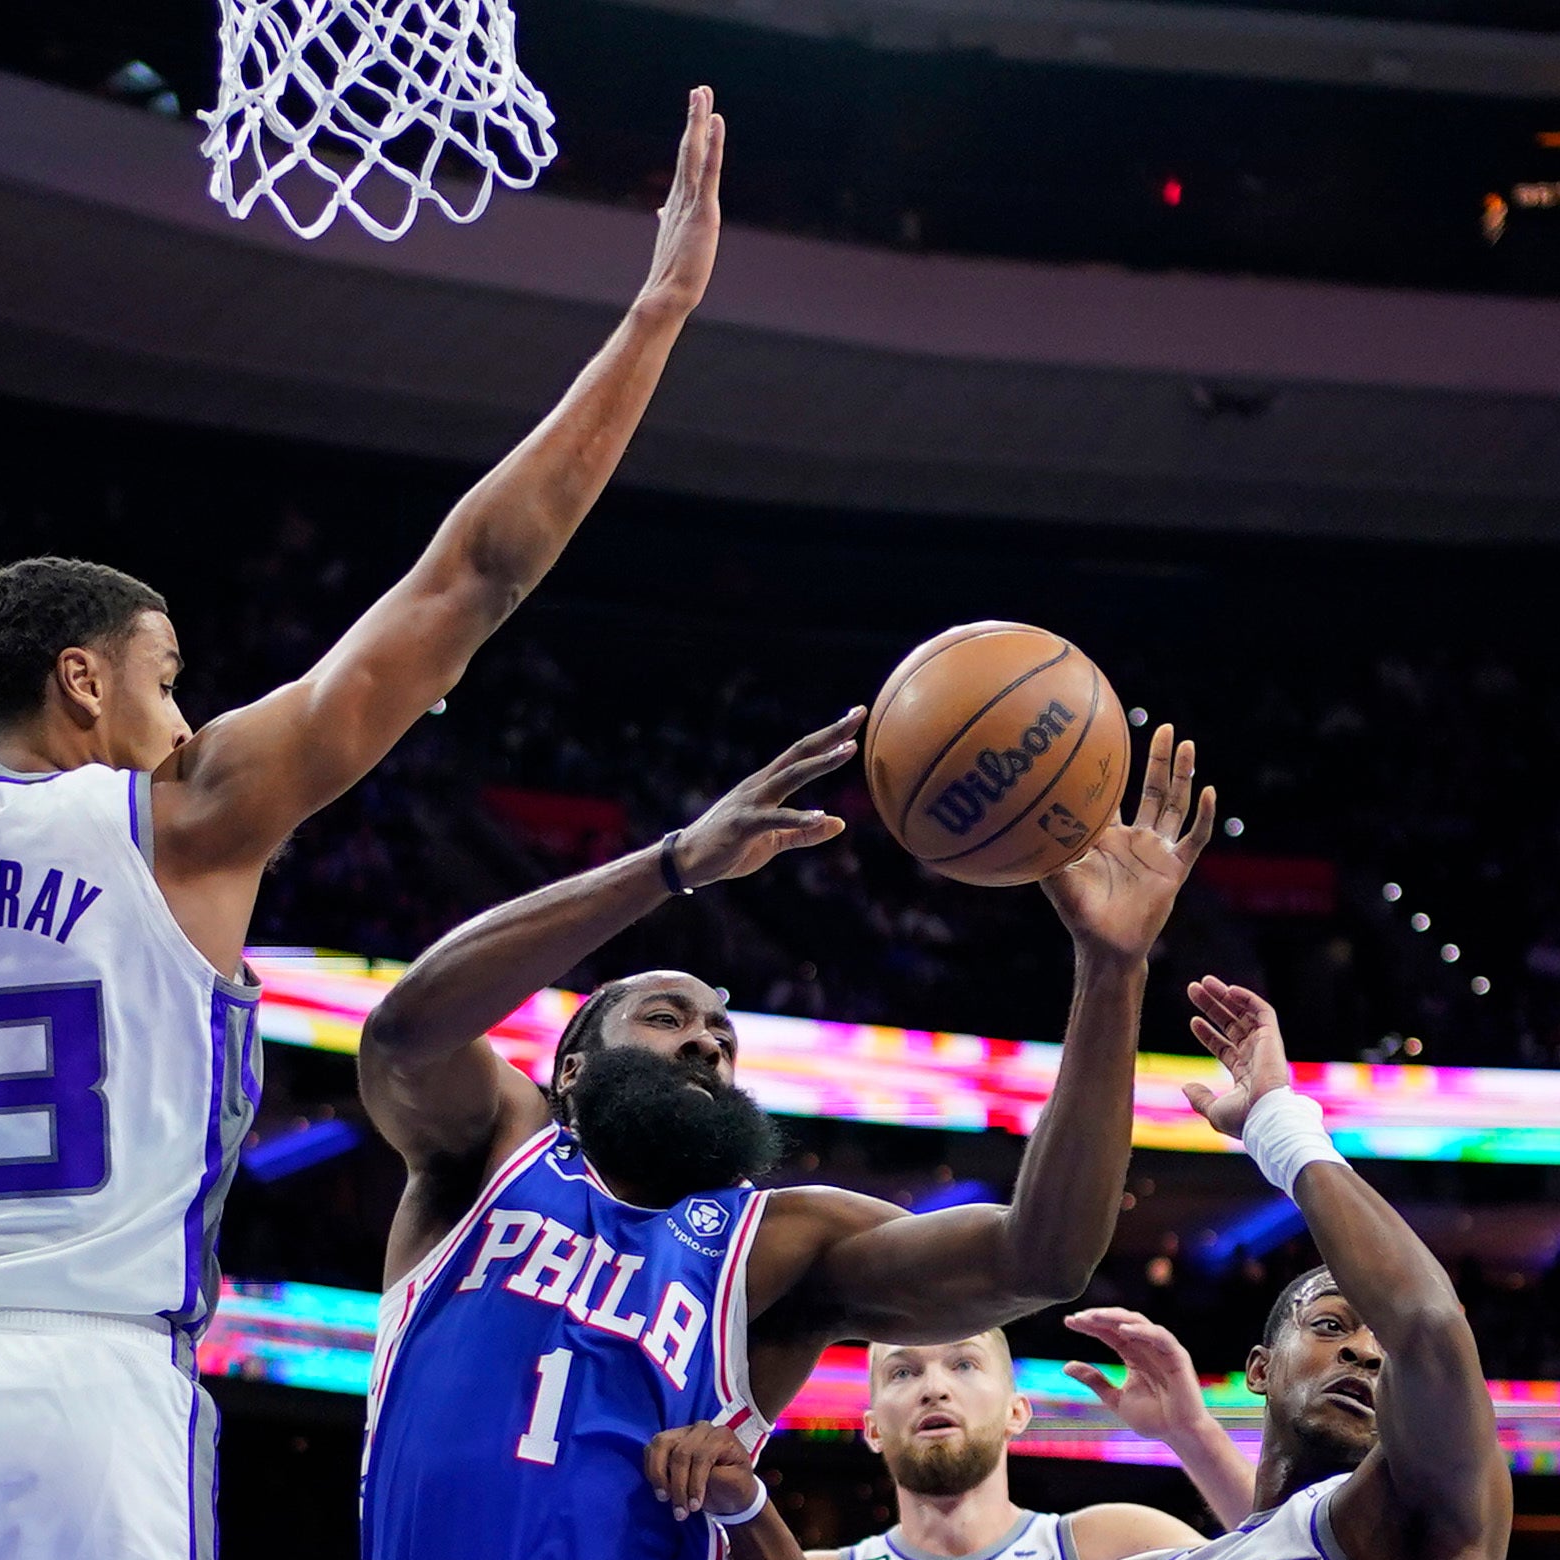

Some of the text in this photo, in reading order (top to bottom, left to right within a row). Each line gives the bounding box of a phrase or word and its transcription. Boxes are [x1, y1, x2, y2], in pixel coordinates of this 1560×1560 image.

[926, 700, 1077, 836] Wilson
[458, 1208, 707, 1391] PHILA
[516, 1347, 574, 1466] 1
